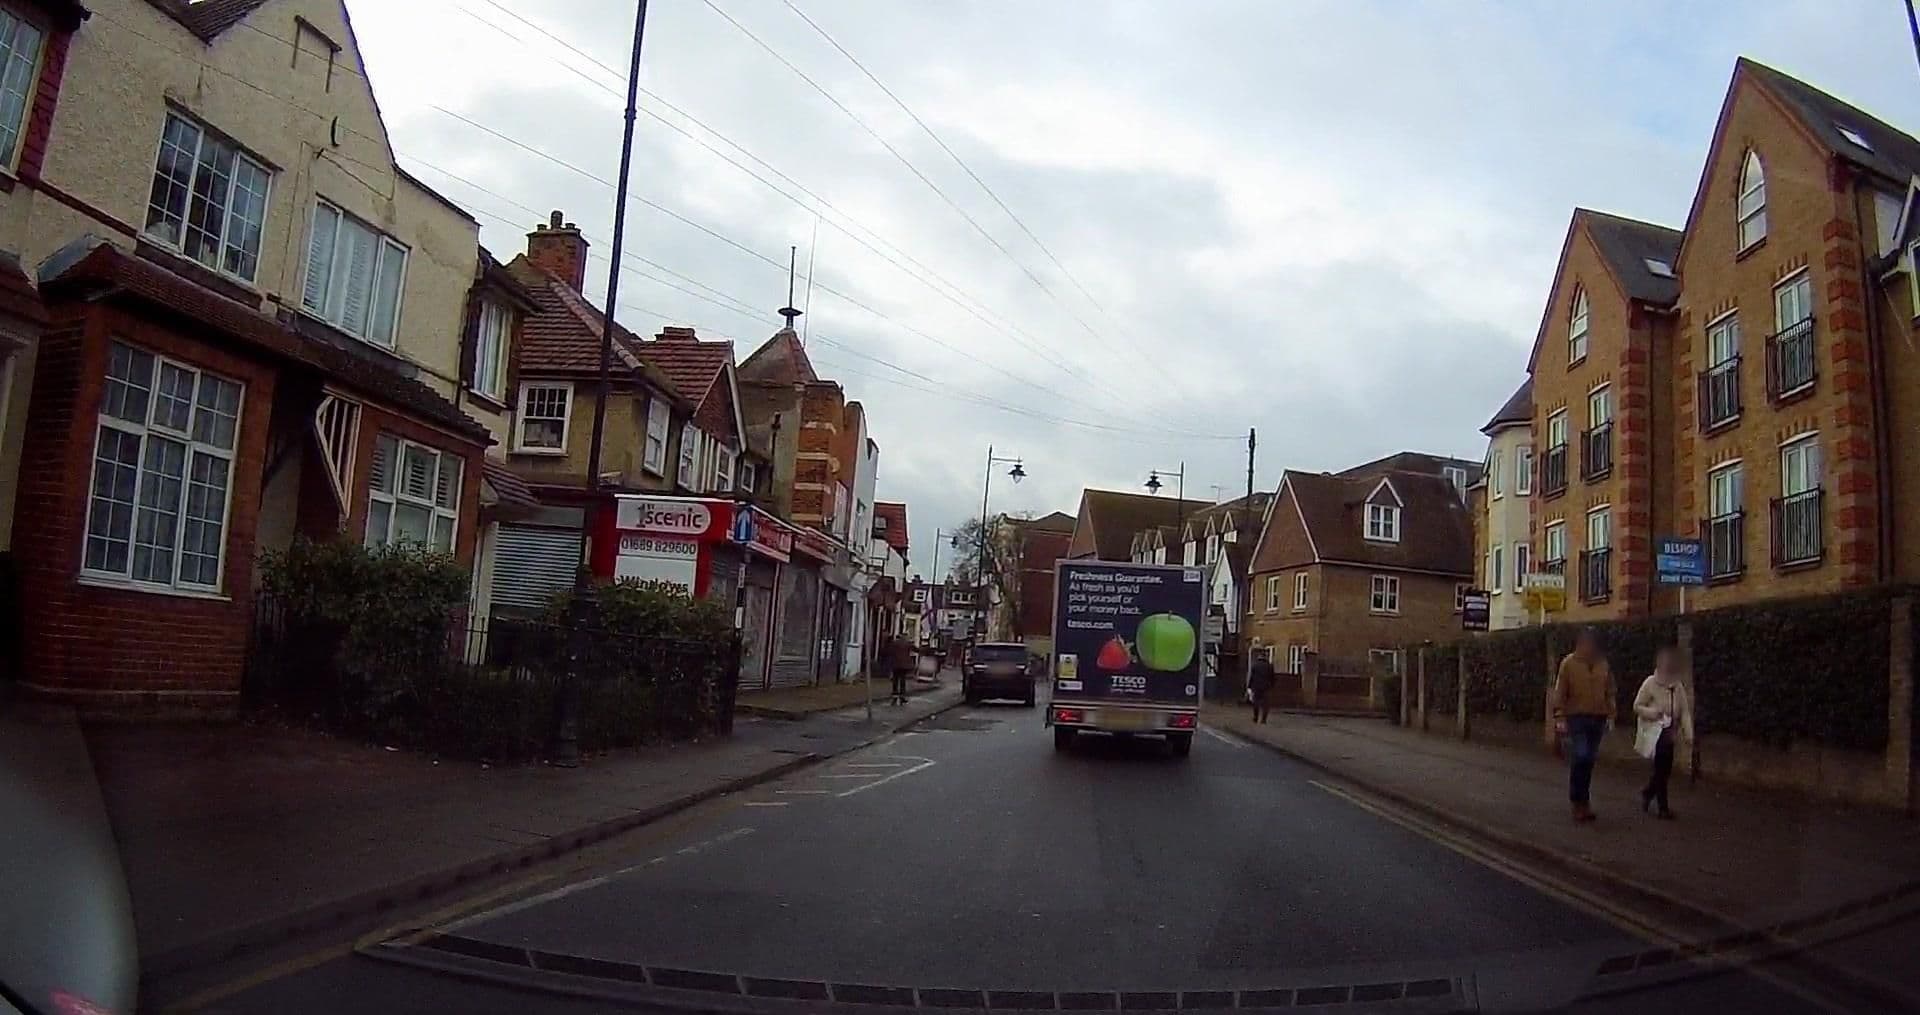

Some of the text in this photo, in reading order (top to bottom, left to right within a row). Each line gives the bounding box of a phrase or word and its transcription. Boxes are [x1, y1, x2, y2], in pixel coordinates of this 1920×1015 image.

[645, 507, 702, 528] scenic
[1664, 543, 1697, 554] BISHOP
[1070, 571, 1113, 582] Freshness
[1069, 583, 1080, 592] As
[1082, 583, 1104, 592] fresh
[1117, 584, 1140, 594] you'd
[1069, 593, 1086, 603] pick
[1088, 594, 1121, 604] yourself
[1068, 604, 1087, 613] your
[1089, 606, 1118, 615] money
[1067, 619, 1114, 629] tesco.com
[1111, 675, 1146, 685] TESCO
